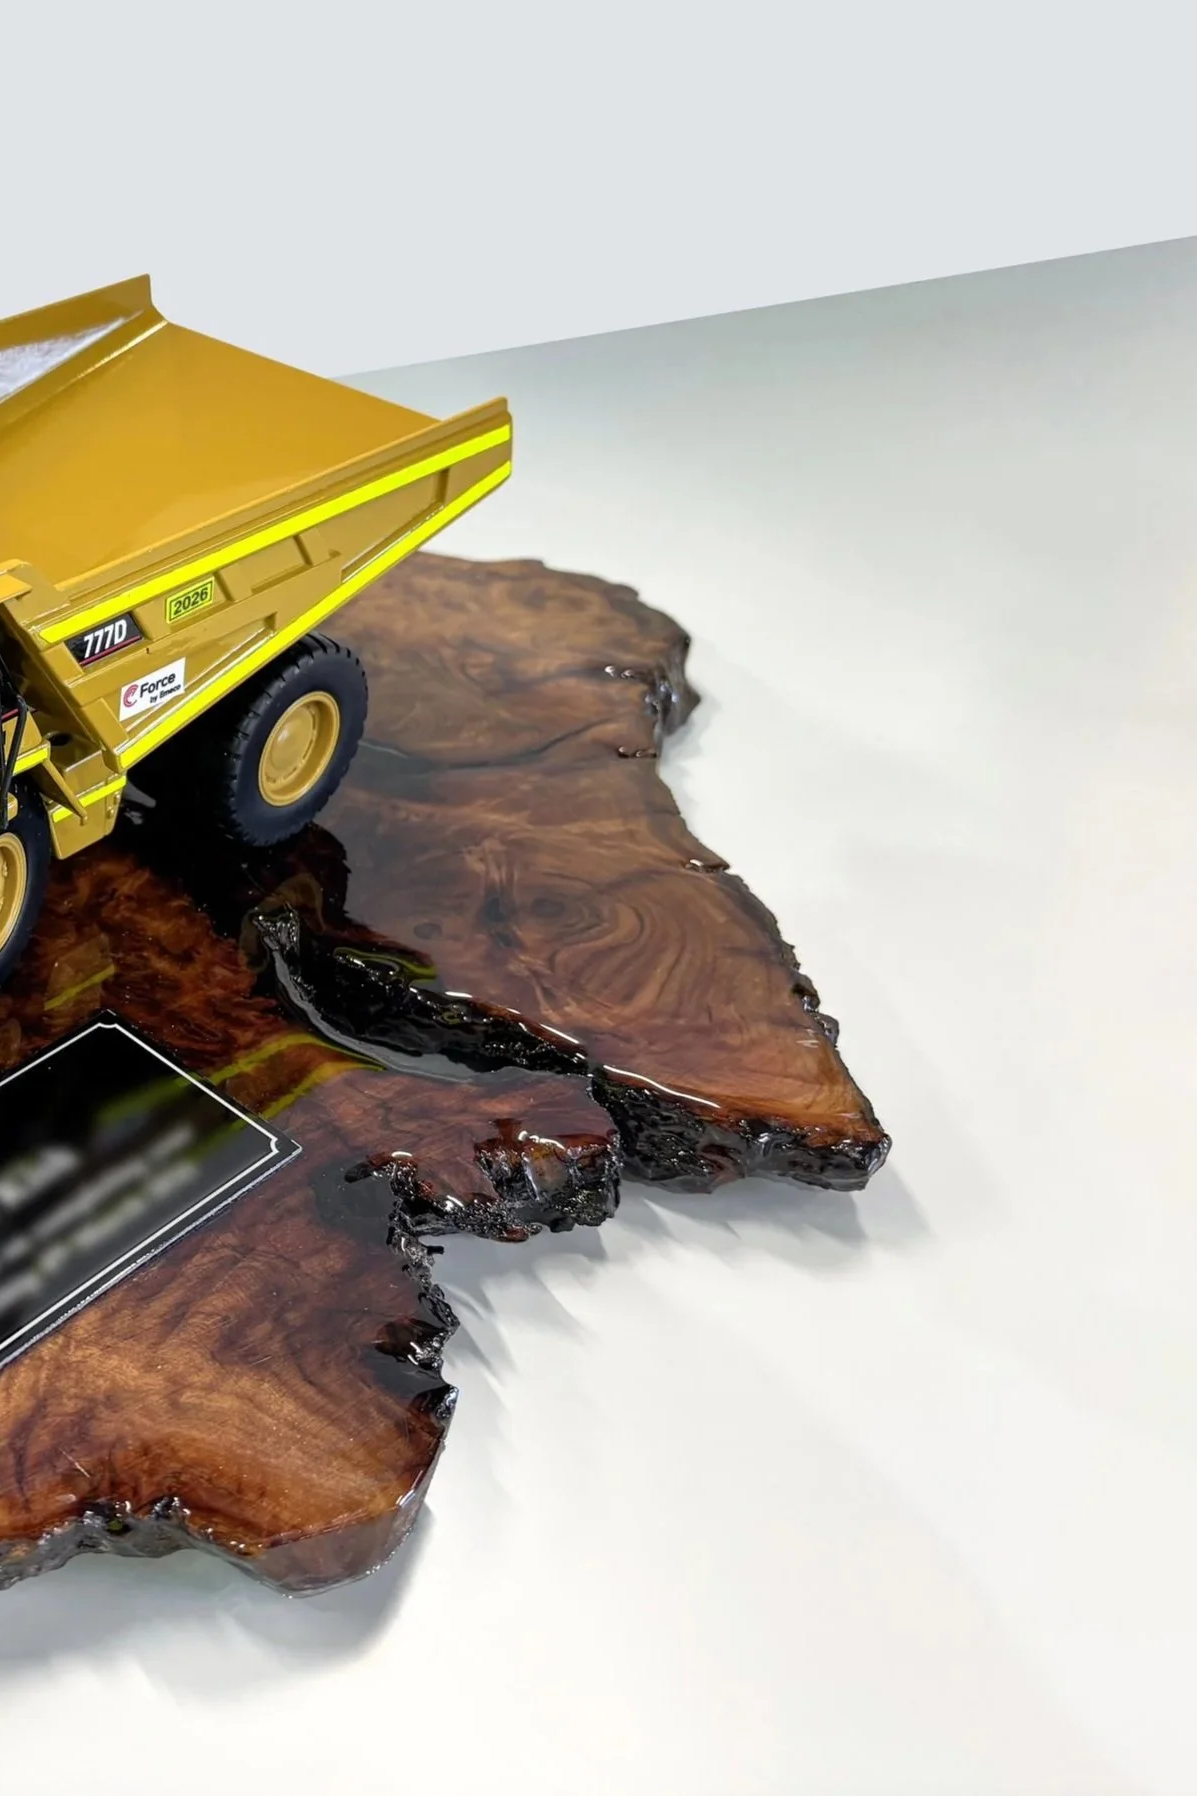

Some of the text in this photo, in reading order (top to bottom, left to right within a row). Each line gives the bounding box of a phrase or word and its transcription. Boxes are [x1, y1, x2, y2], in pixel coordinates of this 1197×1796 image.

[173, 587, 209, 616] 2026
[83, 619, 127, 658] 777D
[140, 673, 176, 697] Force
